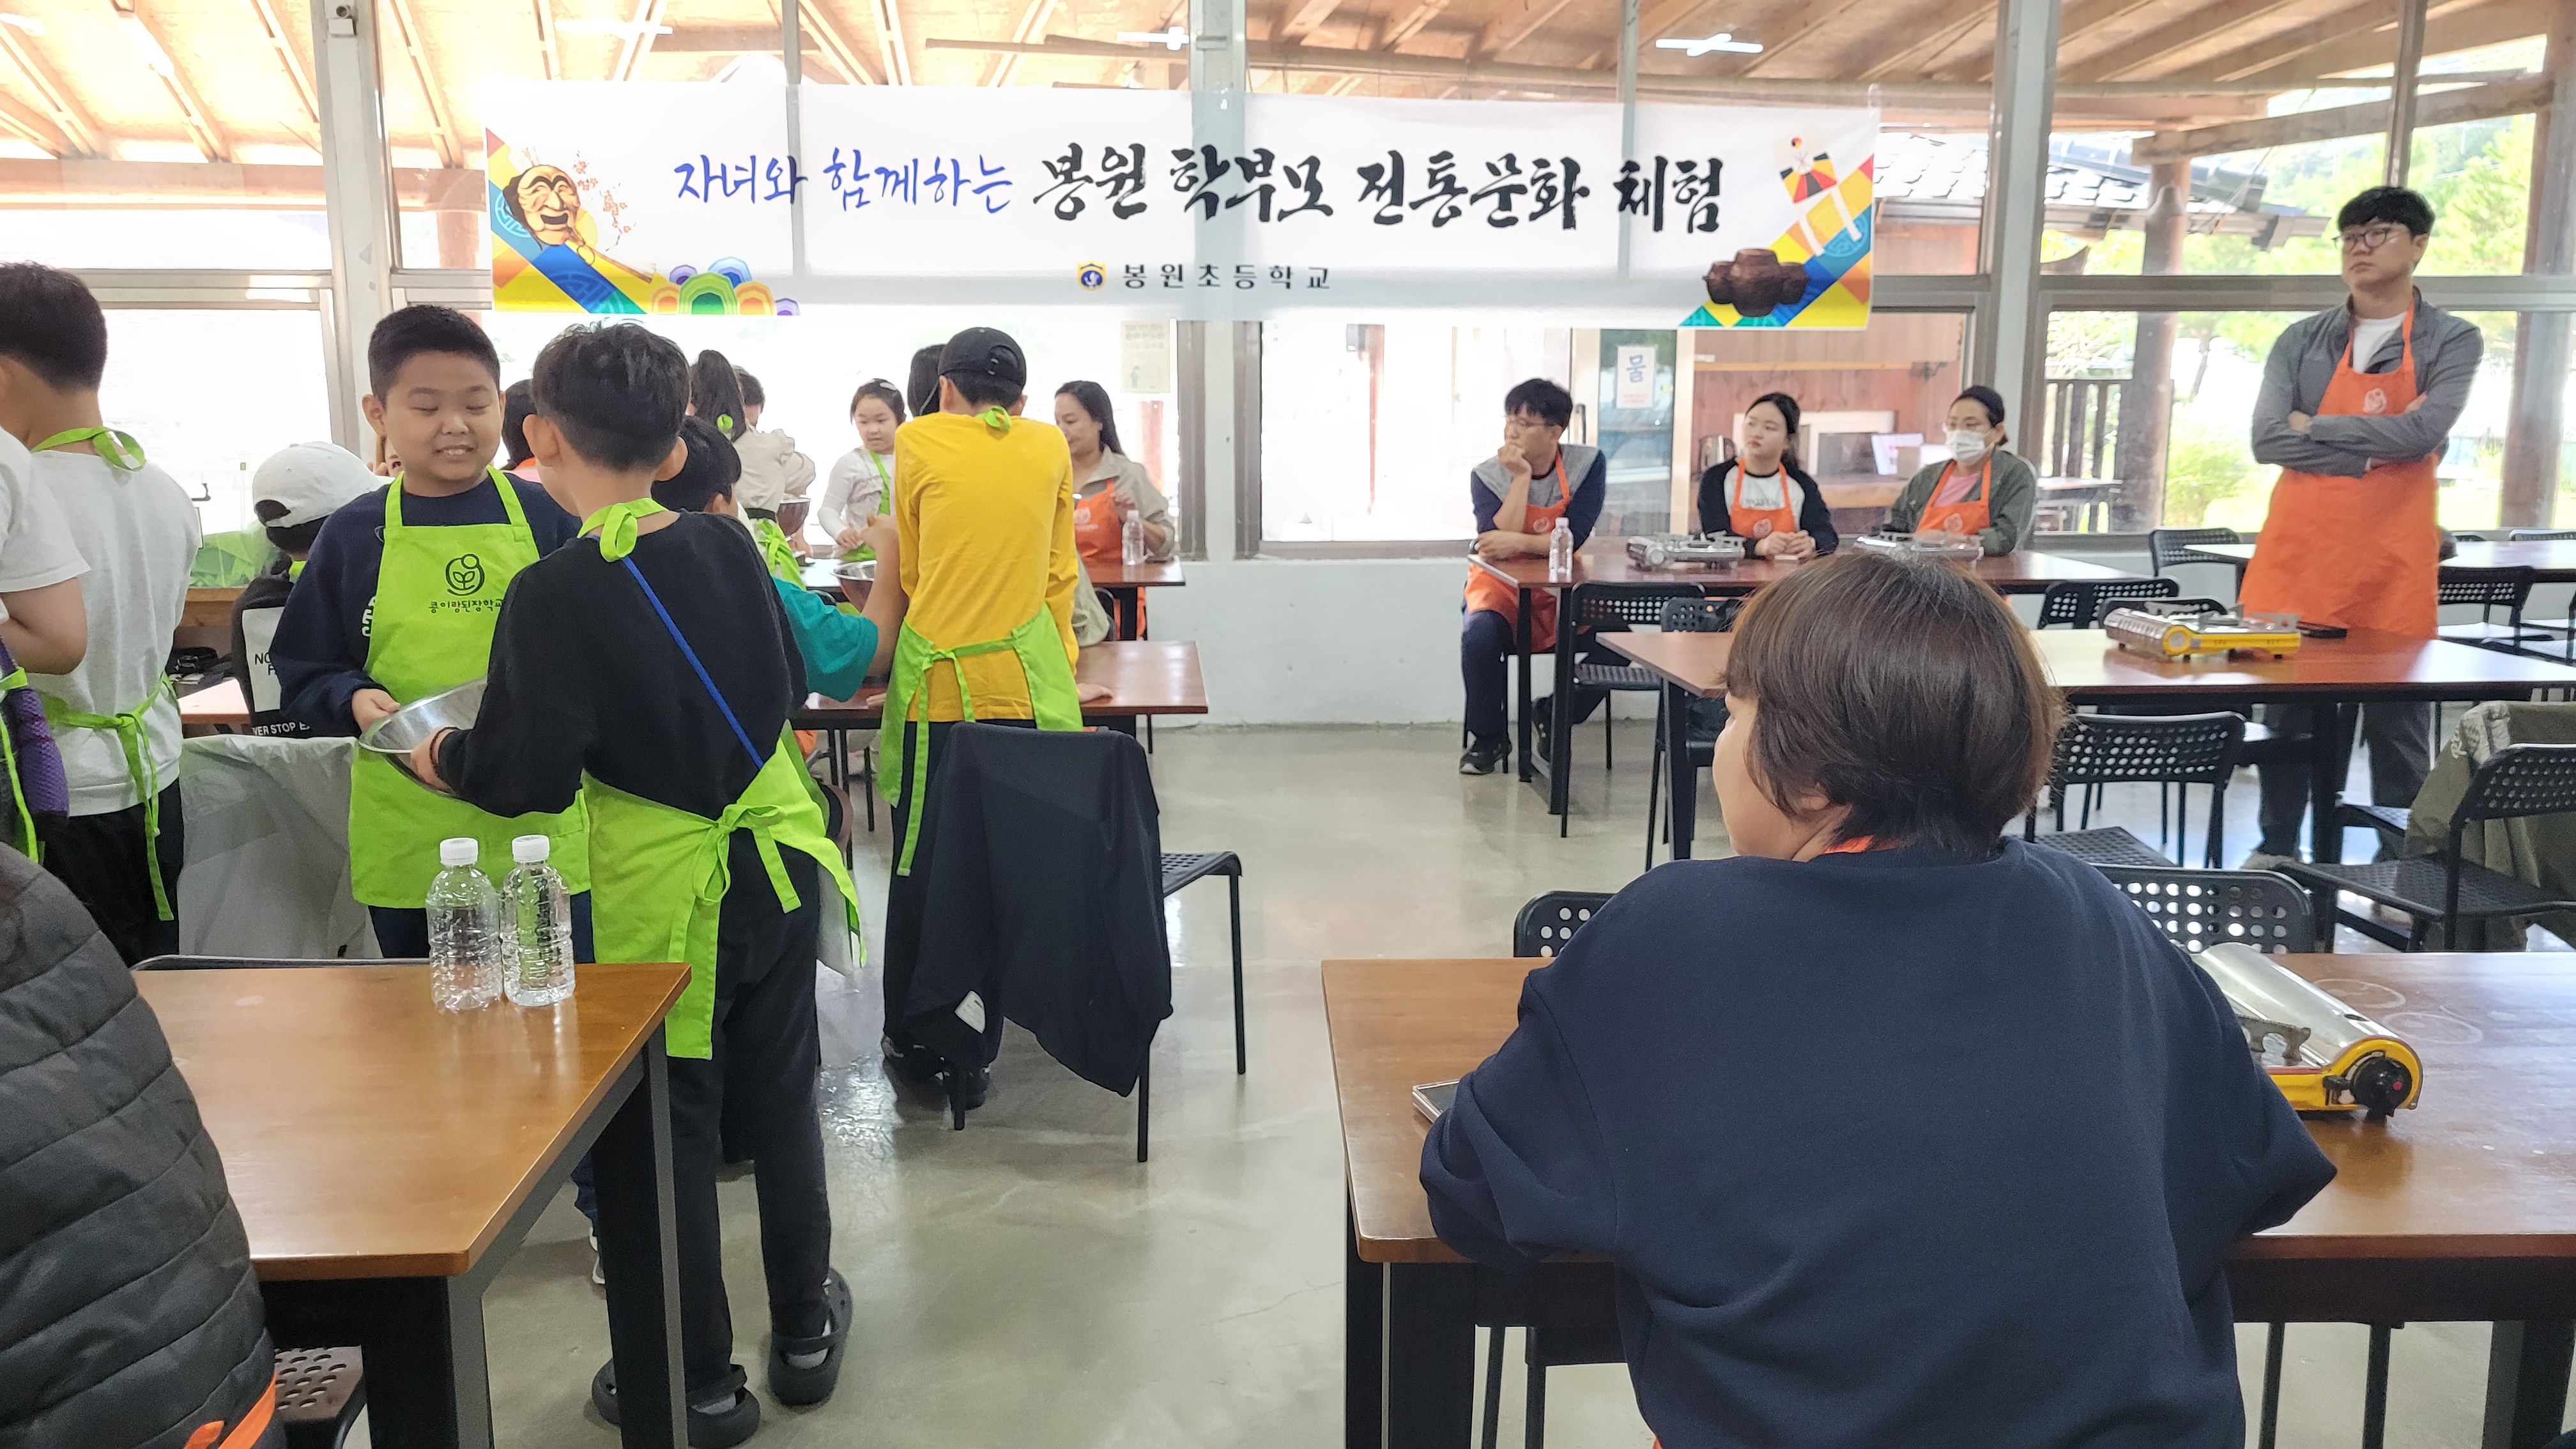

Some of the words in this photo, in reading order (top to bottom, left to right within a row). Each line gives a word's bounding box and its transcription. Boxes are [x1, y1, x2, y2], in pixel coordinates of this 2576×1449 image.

[674, 155, 808, 204] 자녀와
[823, 148, 1013, 213] 함께하는
[1033, 143, 1147, 220] 봉원
[1170, 144, 1333, 222] 학부모
[1358, 150, 1590, 230] 전통문화
[1613, 155, 1723, 233] 체험
[1123, 264, 1330, 289] 봉원초등학교
[270, 722, 296, 734] STOP
